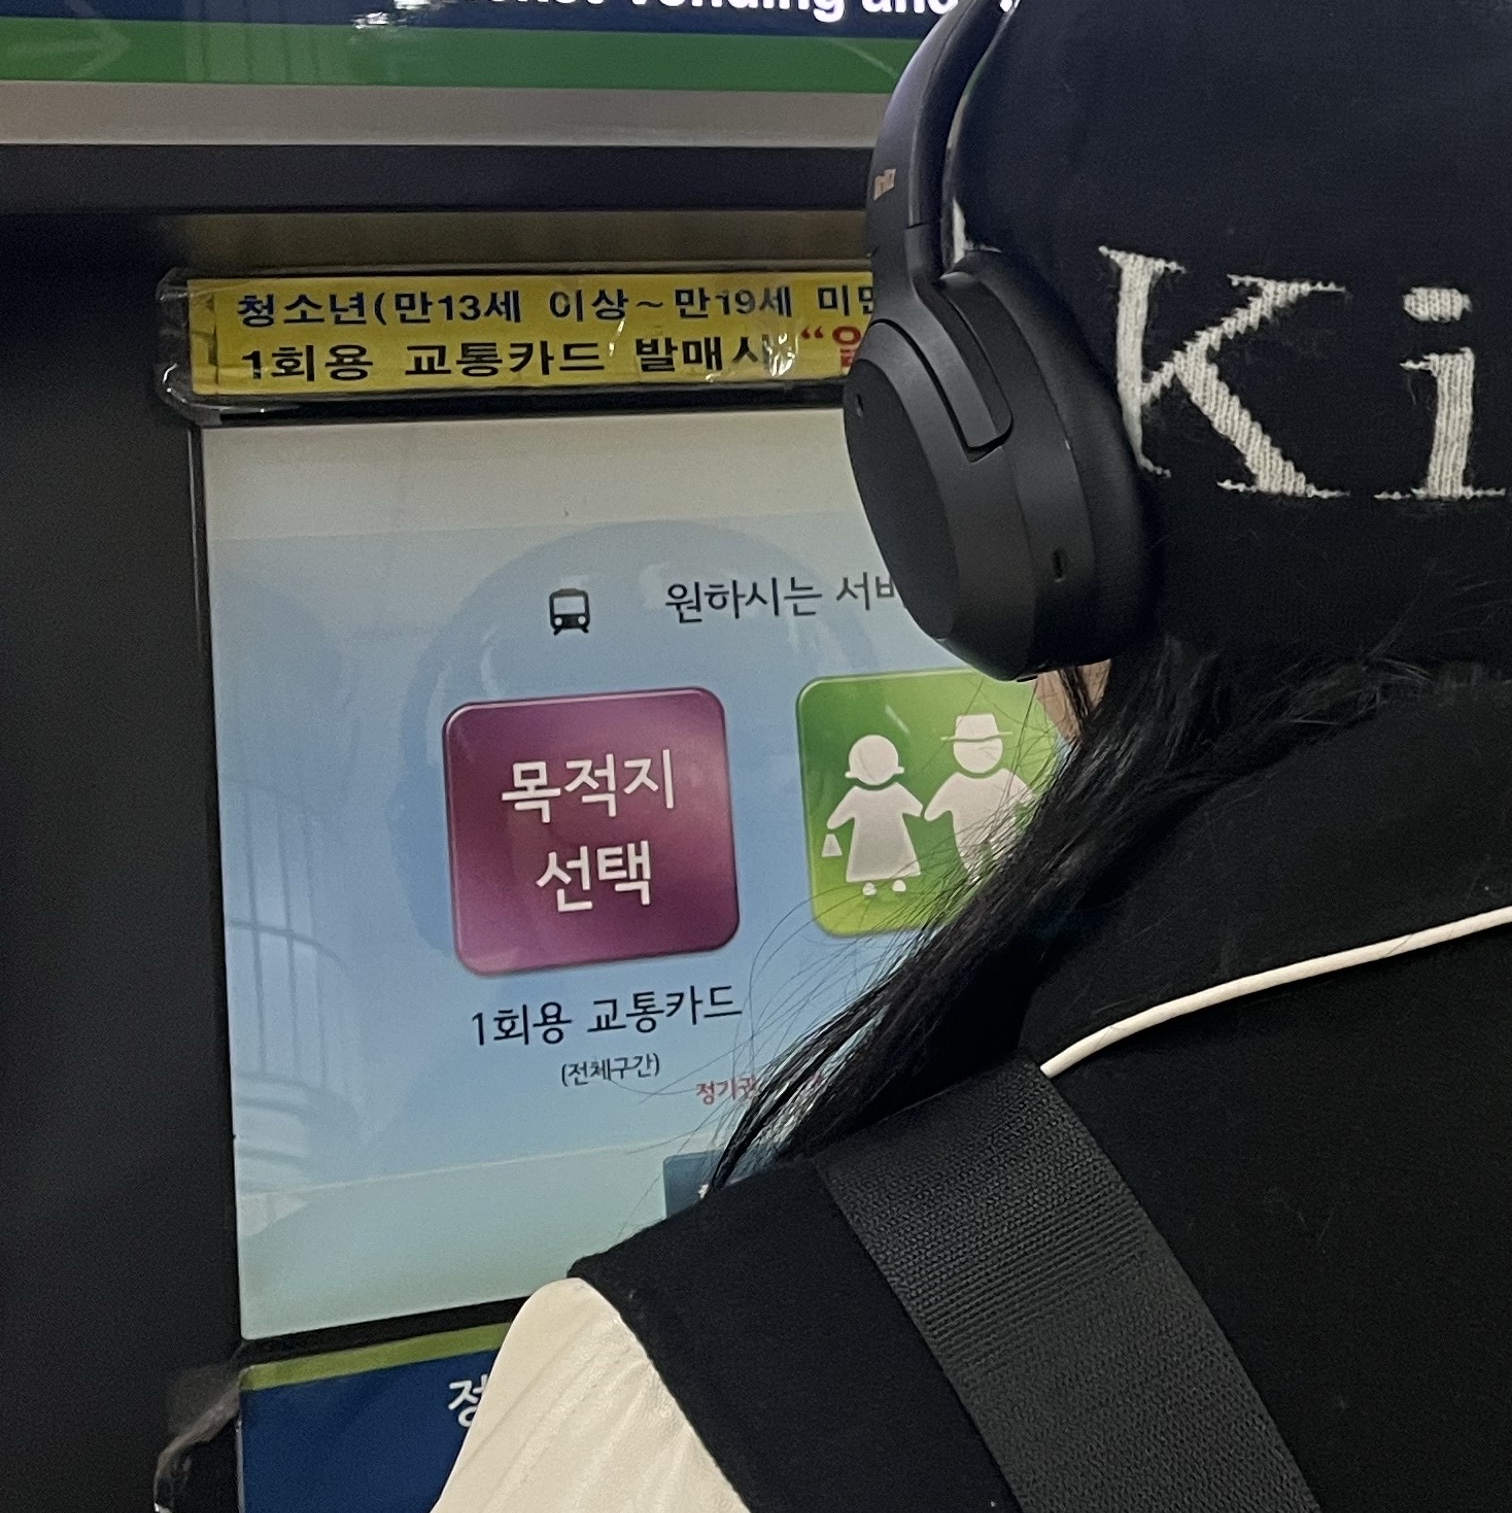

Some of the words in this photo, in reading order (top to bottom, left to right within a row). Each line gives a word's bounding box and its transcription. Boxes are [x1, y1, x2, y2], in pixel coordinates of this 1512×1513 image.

[238, 290, 521, 327] 청소년(만13세
[242, 344, 373, 381] 1회용
[405, 341, 604, 376] 교통카드
[665, 576, 823, 624] 원하시는
[502, 749, 674, 823] 목적지
[536, 840, 651, 913] 선택
[472, 1001, 572, 1046] 1회용
[587, 985, 743, 1033] 교통카드
[561, 1053, 660, 1087] (전체구간)
